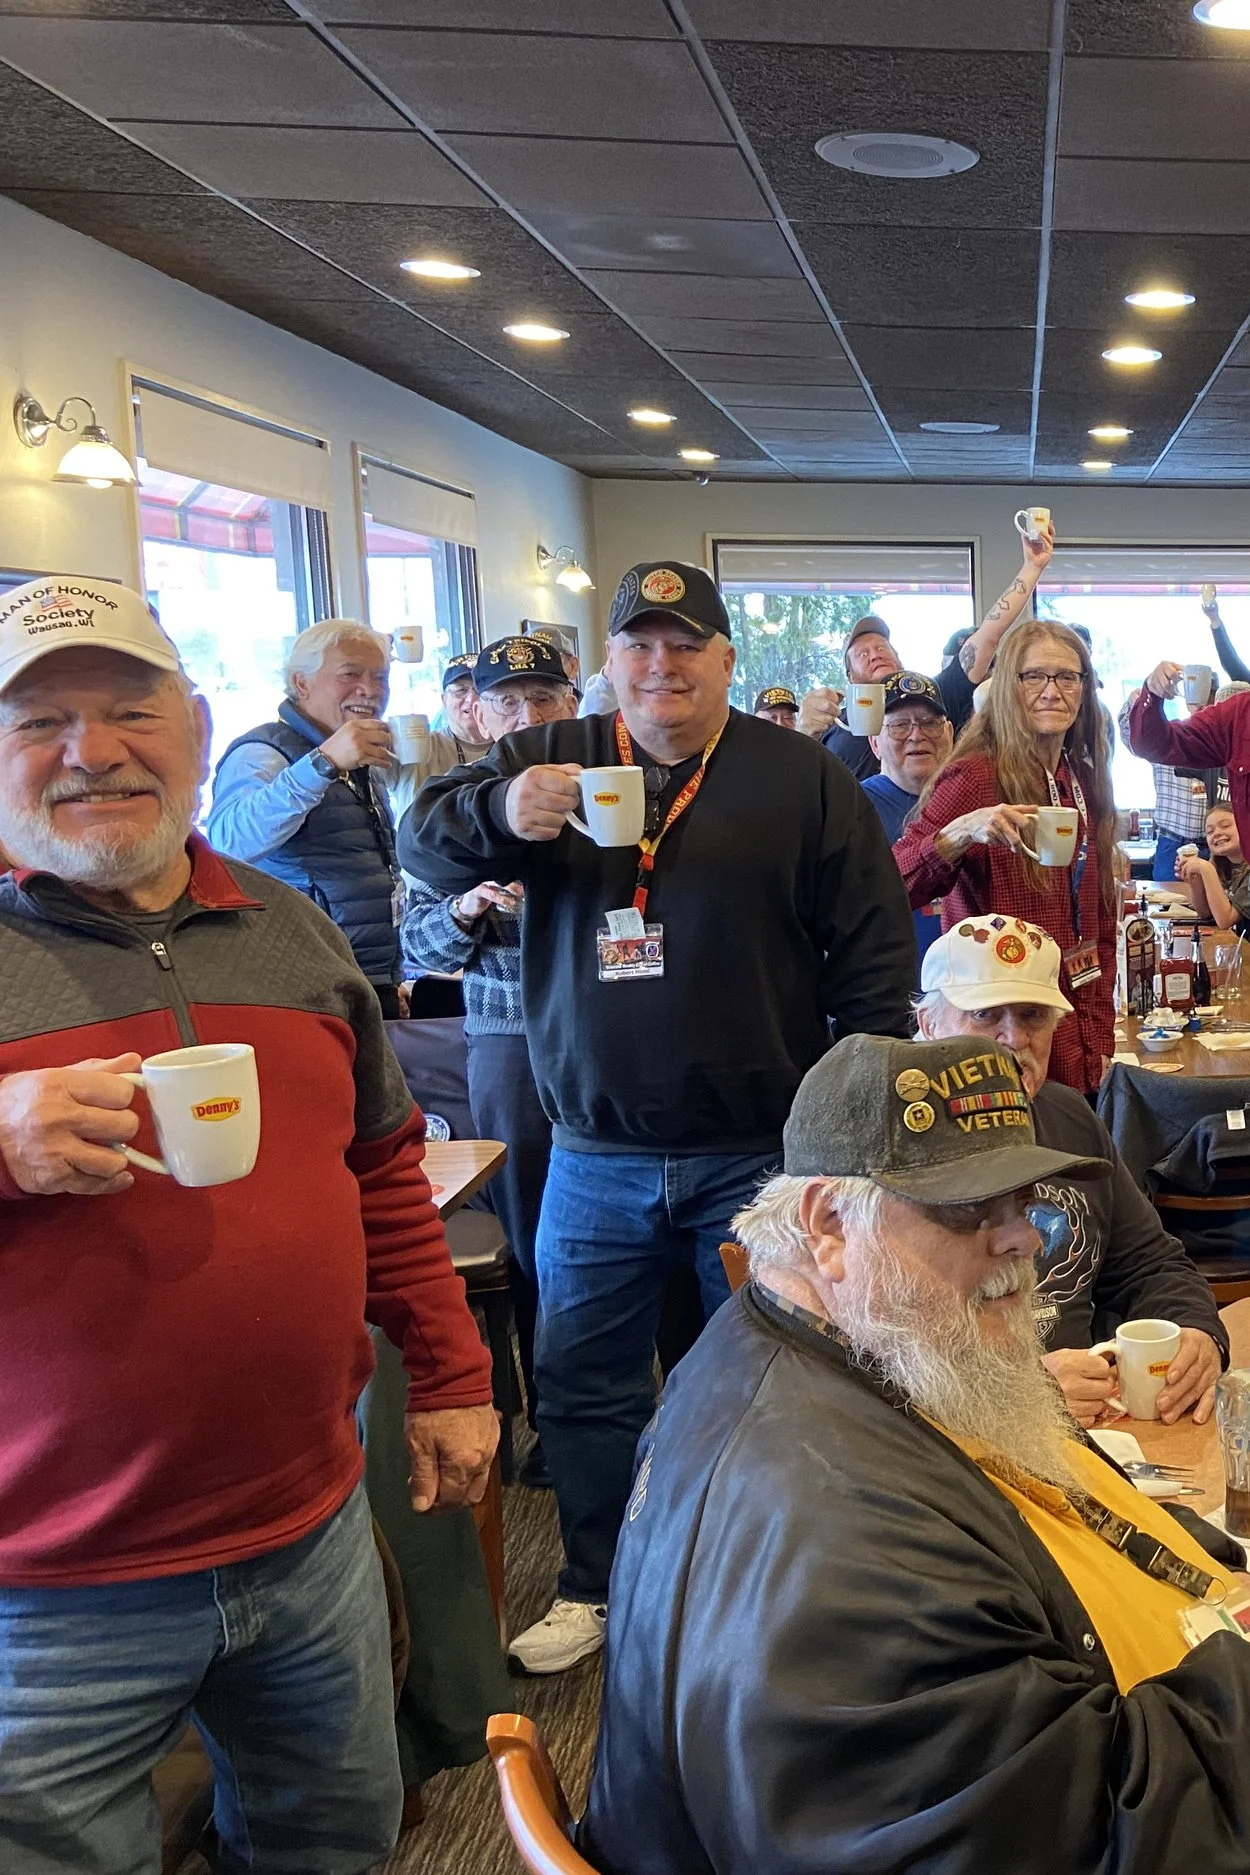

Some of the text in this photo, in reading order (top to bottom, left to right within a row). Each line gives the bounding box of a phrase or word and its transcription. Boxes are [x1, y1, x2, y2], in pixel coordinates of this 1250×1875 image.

[0, 585, 119, 624] MAN OF HONOR
[23, 608, 94, 627] Society
[617, 722, 632, 766] ES.COM
[195, 1100, 240, 1117] Denny's
